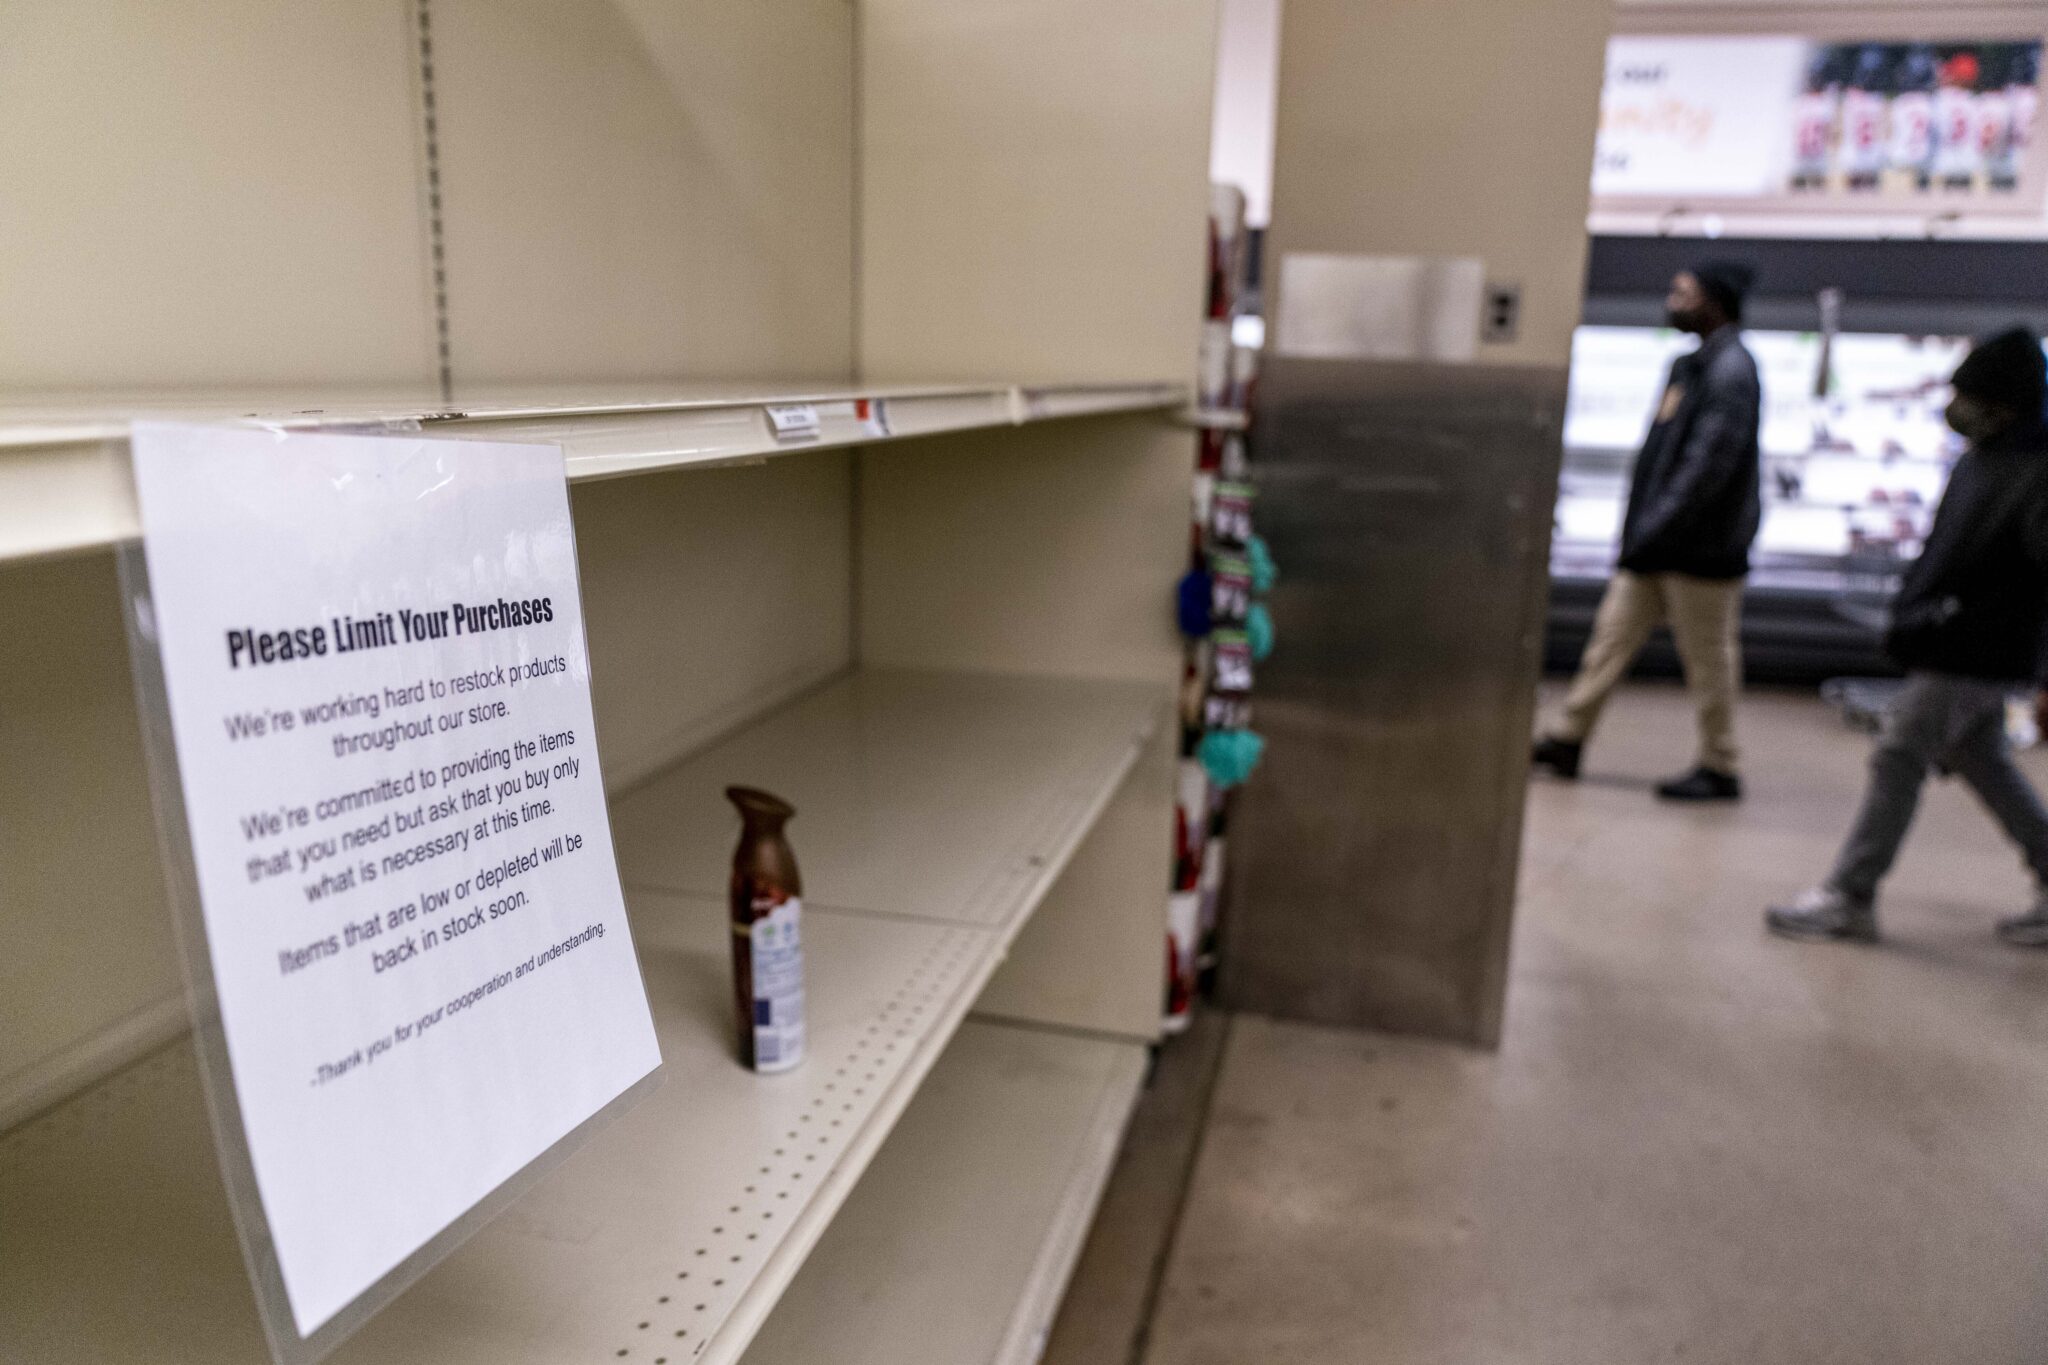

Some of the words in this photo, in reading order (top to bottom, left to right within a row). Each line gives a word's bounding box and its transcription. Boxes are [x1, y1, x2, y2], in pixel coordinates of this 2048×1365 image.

[227, 626, 327, 669] Please
[332, 612, 397, 653] Limit
[398, 608, 449, 643] Your
[452, 597, 554, 636] Purchases
[223, 708, 296, 741] We're
[300, 692, 380, 726] working
[383, 680, 425, 709] hard
[429, 679, 446, 699] to
[451, 665, 506, 695] restock
[509, 654, 567, 688] products
[332, 714, 434, 758] throughout
[438, 710, 464, 731] our
[468, 701, 510, 724] store.
[239, 806, 310, 842] We're
[315, 770, 416, 821] committed
[420, 769, 437, 790] to
[441, 748, 511, 788] providing
[514, 740, 537, 761] the
[539, 729, 575, 753] items
[246, 848, 292, 883] that
[297, 837, 337, 873] you
[341, 814, 391, 851] need
[394, 805, 425, 833] but
[428, 795, 459, 823] ask
[462, 783, 492, 811] that
[495, 777, 522, 805] you
[524, 767, 550, 789] buy
[553, 756, 580, 778] only
[304, 866, 356, 903] what
[360, 859, 377, 883] is
[382, 828, 470, 876] necessary
[474, 817, 490, 841] at
[492, 808, 519, 834] this
[521, 799, 555, 823] time.
[278, 934, 341, 976] Items
[343, 913, 383, 948] that
[387, 902, 417, 930] are
[420, 888, 450, 915] low
[455, 878, 471, 900] or
[475, 847, 539, 891] depleted
[541, 837, 563, 863] will
[565, 833, 583, 853] be
[371, 936, 418, 974] back
[420, 929, 439, 951] in
[442, 905, 486, 942] stock
[488, 890, 530, 920] soon.
[310, 1049, 363, 1087] -Thank
[366, 1035, 393, 1064] you
[395, 1023, 413, 1042] for
[416, 1006, 444, 1037] your
[446, 970, 513, 1016] cooperation
[515, 955, 535, 979] and
[537, 922, 606, 967] understanding.
